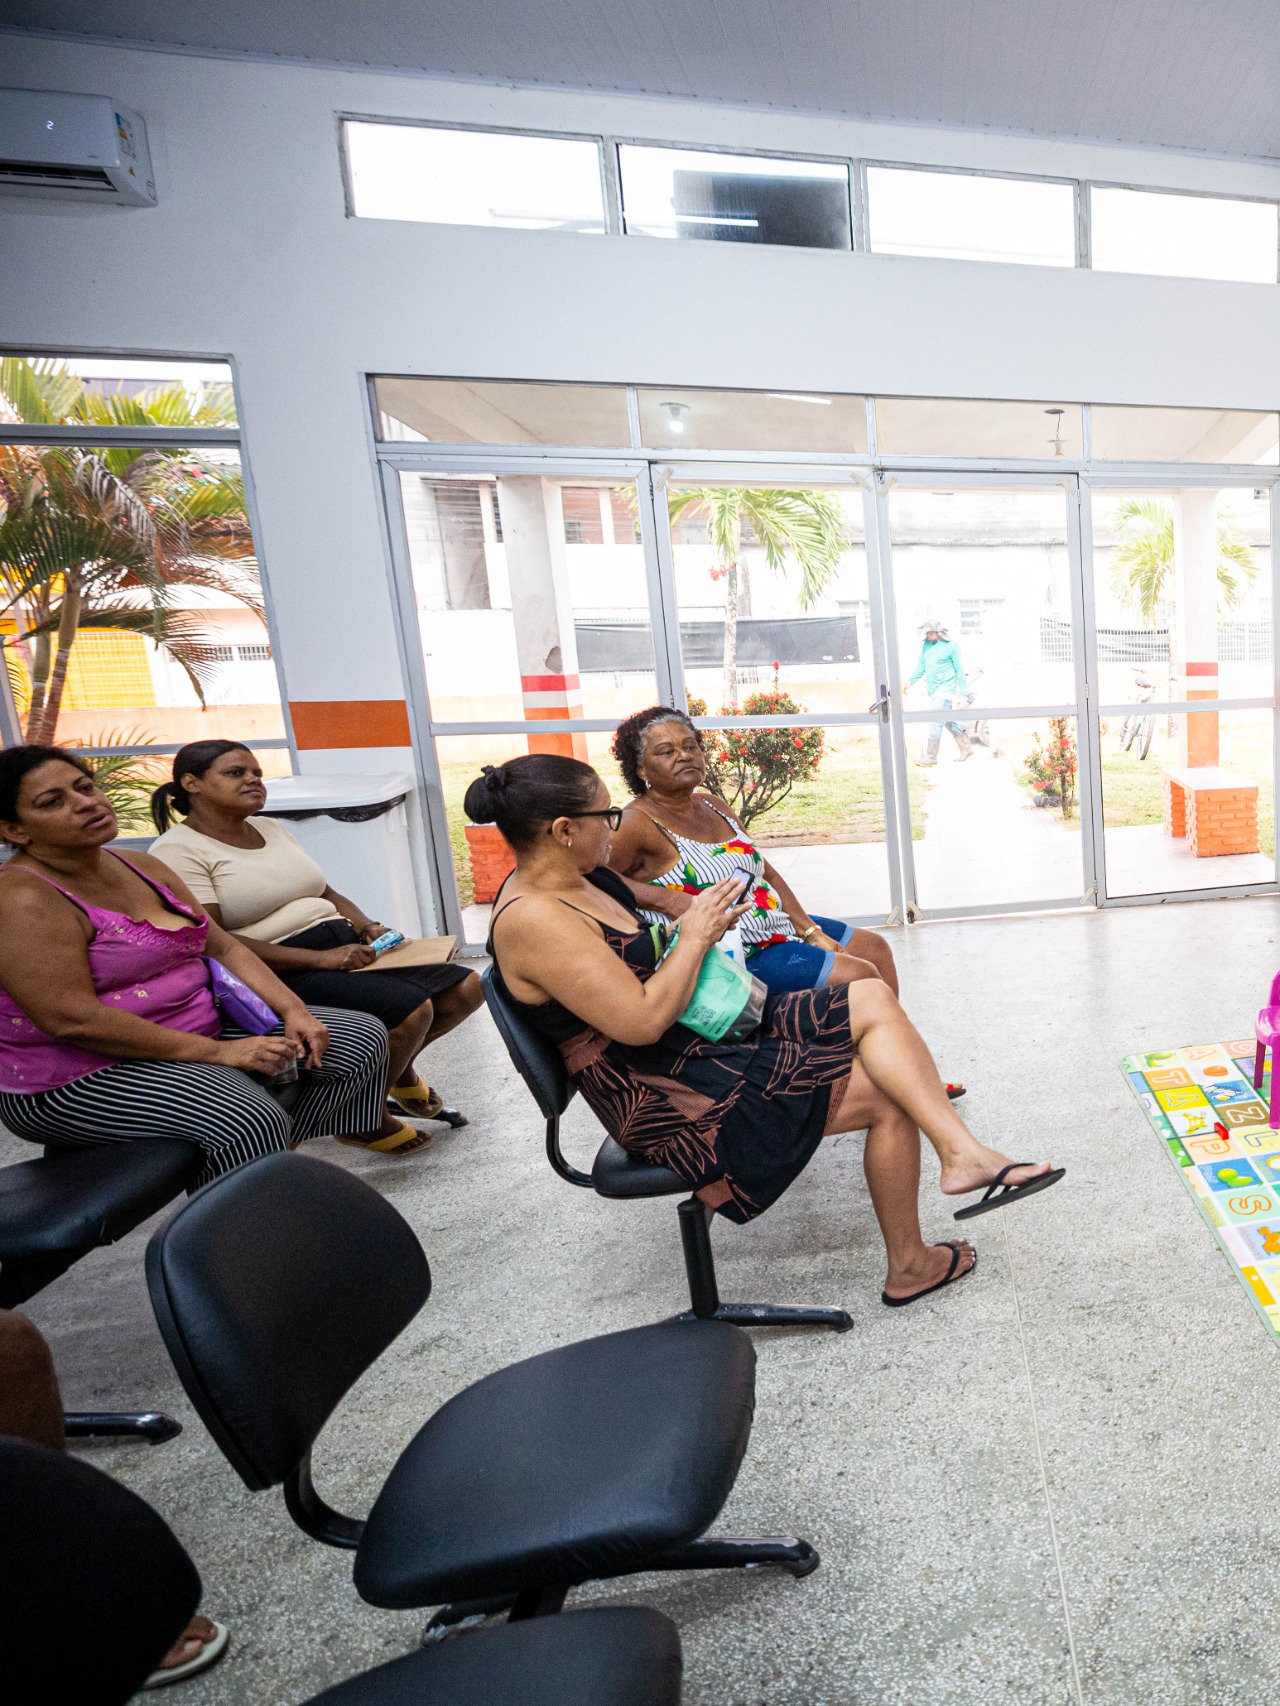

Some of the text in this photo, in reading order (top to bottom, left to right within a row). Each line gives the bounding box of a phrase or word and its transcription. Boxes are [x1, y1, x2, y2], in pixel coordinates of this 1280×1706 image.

[1151, 1070, 1187, 1087] T
[1163, 1093, 1199, 1109] A
[1225, 1106, 1266, 1125] Z
[1189, 1138, 1231, 1155] P
[1243, 1130, 1279, 1148] L
[1228, 1194, 1272, 1216] S
